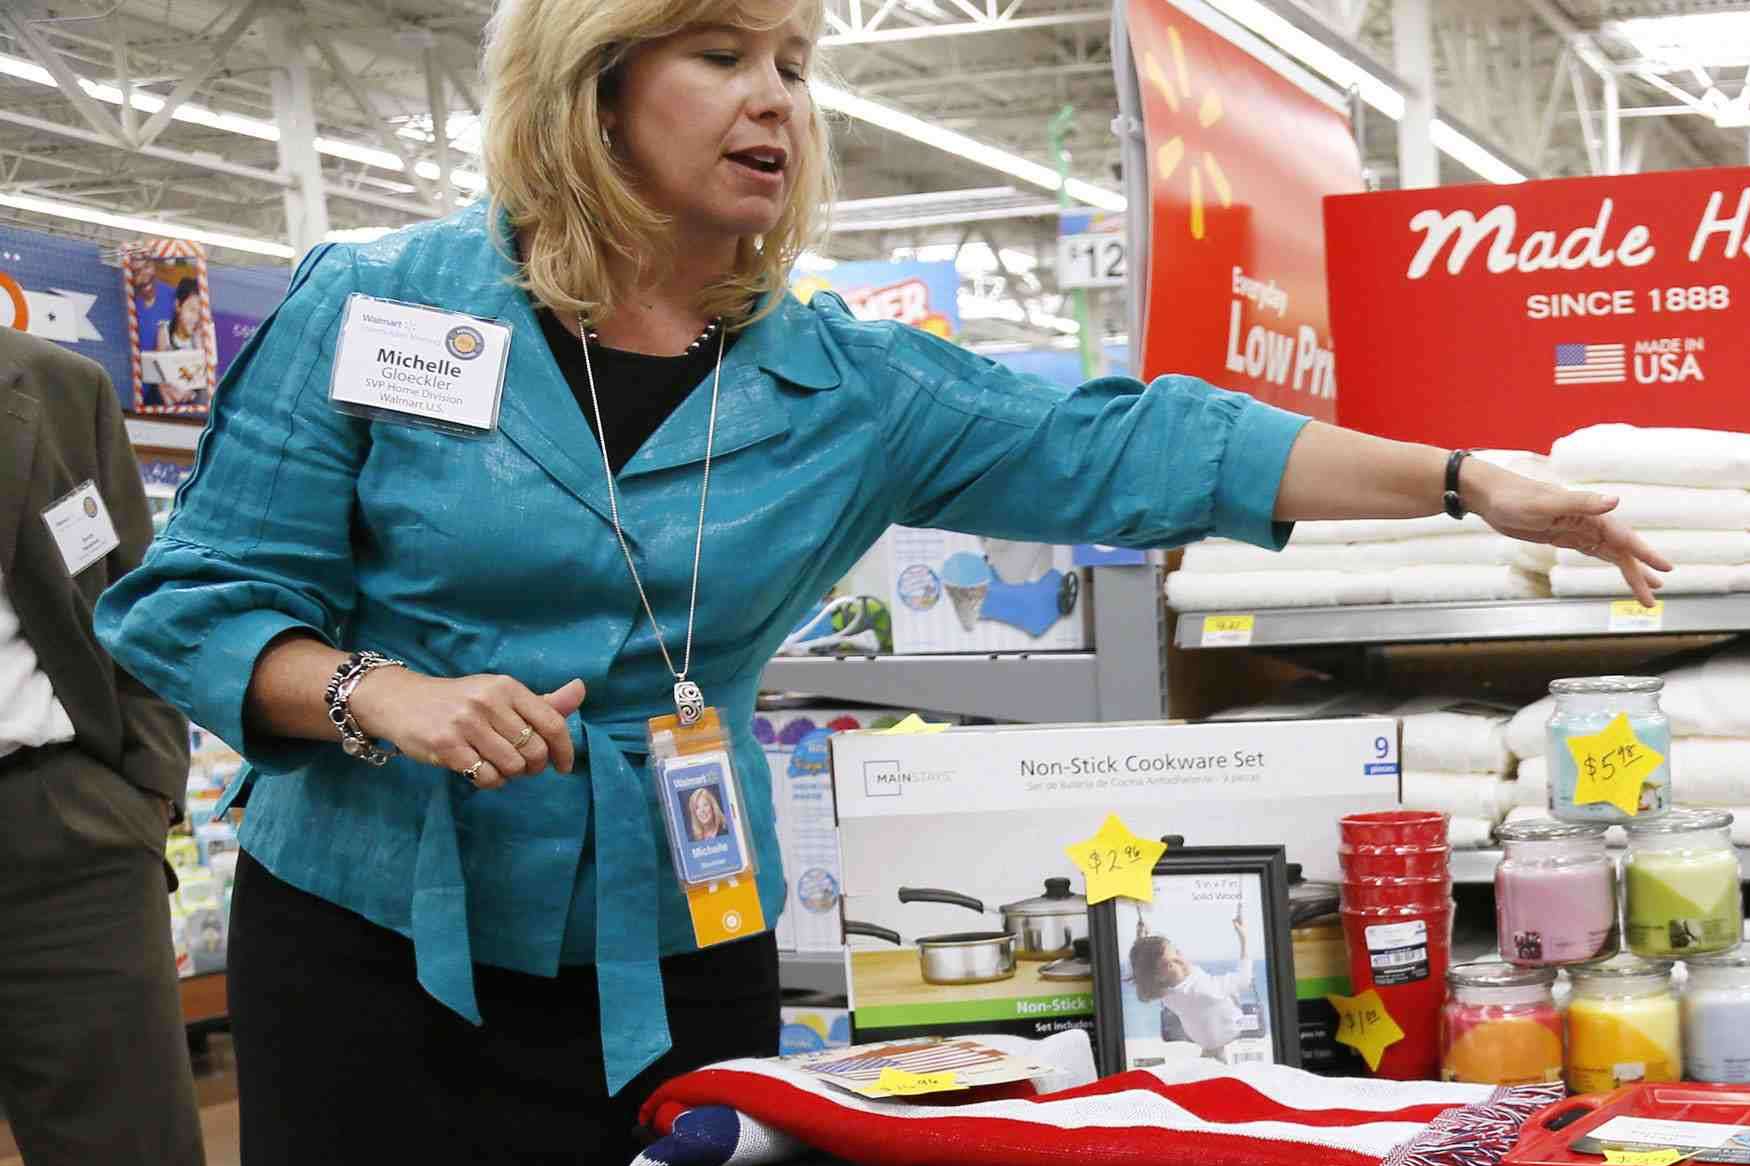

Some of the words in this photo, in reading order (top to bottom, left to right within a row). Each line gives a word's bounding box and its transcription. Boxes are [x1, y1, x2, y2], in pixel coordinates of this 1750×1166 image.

[1406, 198, 1655, 279] Made
[1527, 290, 1634, 319] SINCE
[1648, 285, 1730, 311] 1888
[361, 313, 403, 329] Walmart
[1226, 300, 1294, 385] Low
[1293, 324, 1335, 399] Pri
[1634, 339, 1681, 354] MADE
[1684, 337, 1704, 351] IN
[376, 348, 462, 378] Michelle
[1634, 353, 1704, 384] USA
[381, 367, 452, 391] Gloeckler
[380, 393, 424, 409] Walmart
[387, 381, 419, 396] Home
[421, 389, 464, 406] Division
[1374, 736, 1389, 759] 9
[1020, 756, 1118, 777] Non-Stick
[1125, 753, 1227, 772] Cookware
[1234, 750, 1265, 768] Set
[1016, 997, 1086, 1014] Non-Stick
[1035, 1022, 1052, 1032] Set
